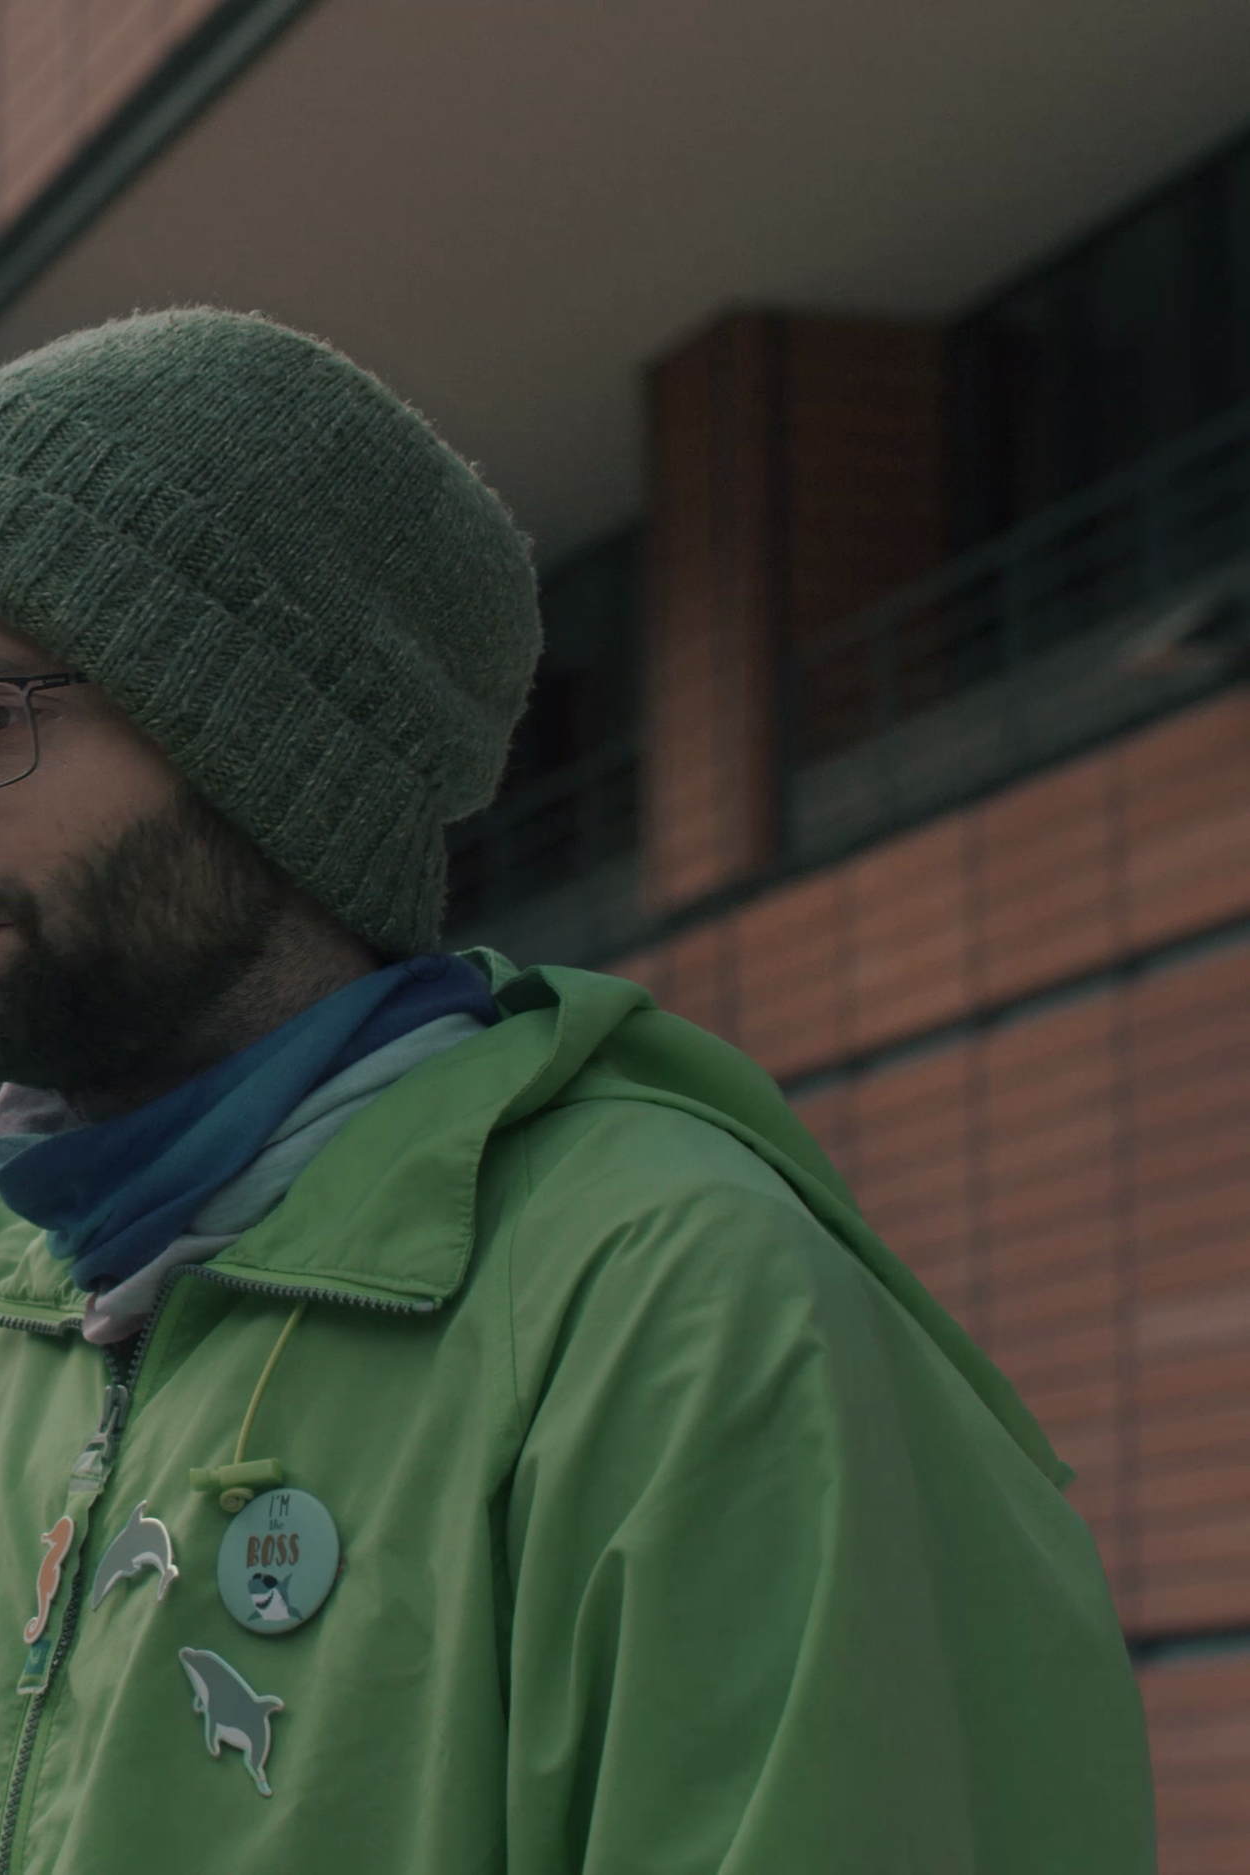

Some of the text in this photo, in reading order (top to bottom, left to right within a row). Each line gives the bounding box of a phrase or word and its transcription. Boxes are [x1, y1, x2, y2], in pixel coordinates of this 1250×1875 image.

[269, 1494, 290, 1517] I'M
[269, 1519, 284, 1531] the
[246, 1533, 299, 1569] BOSS
